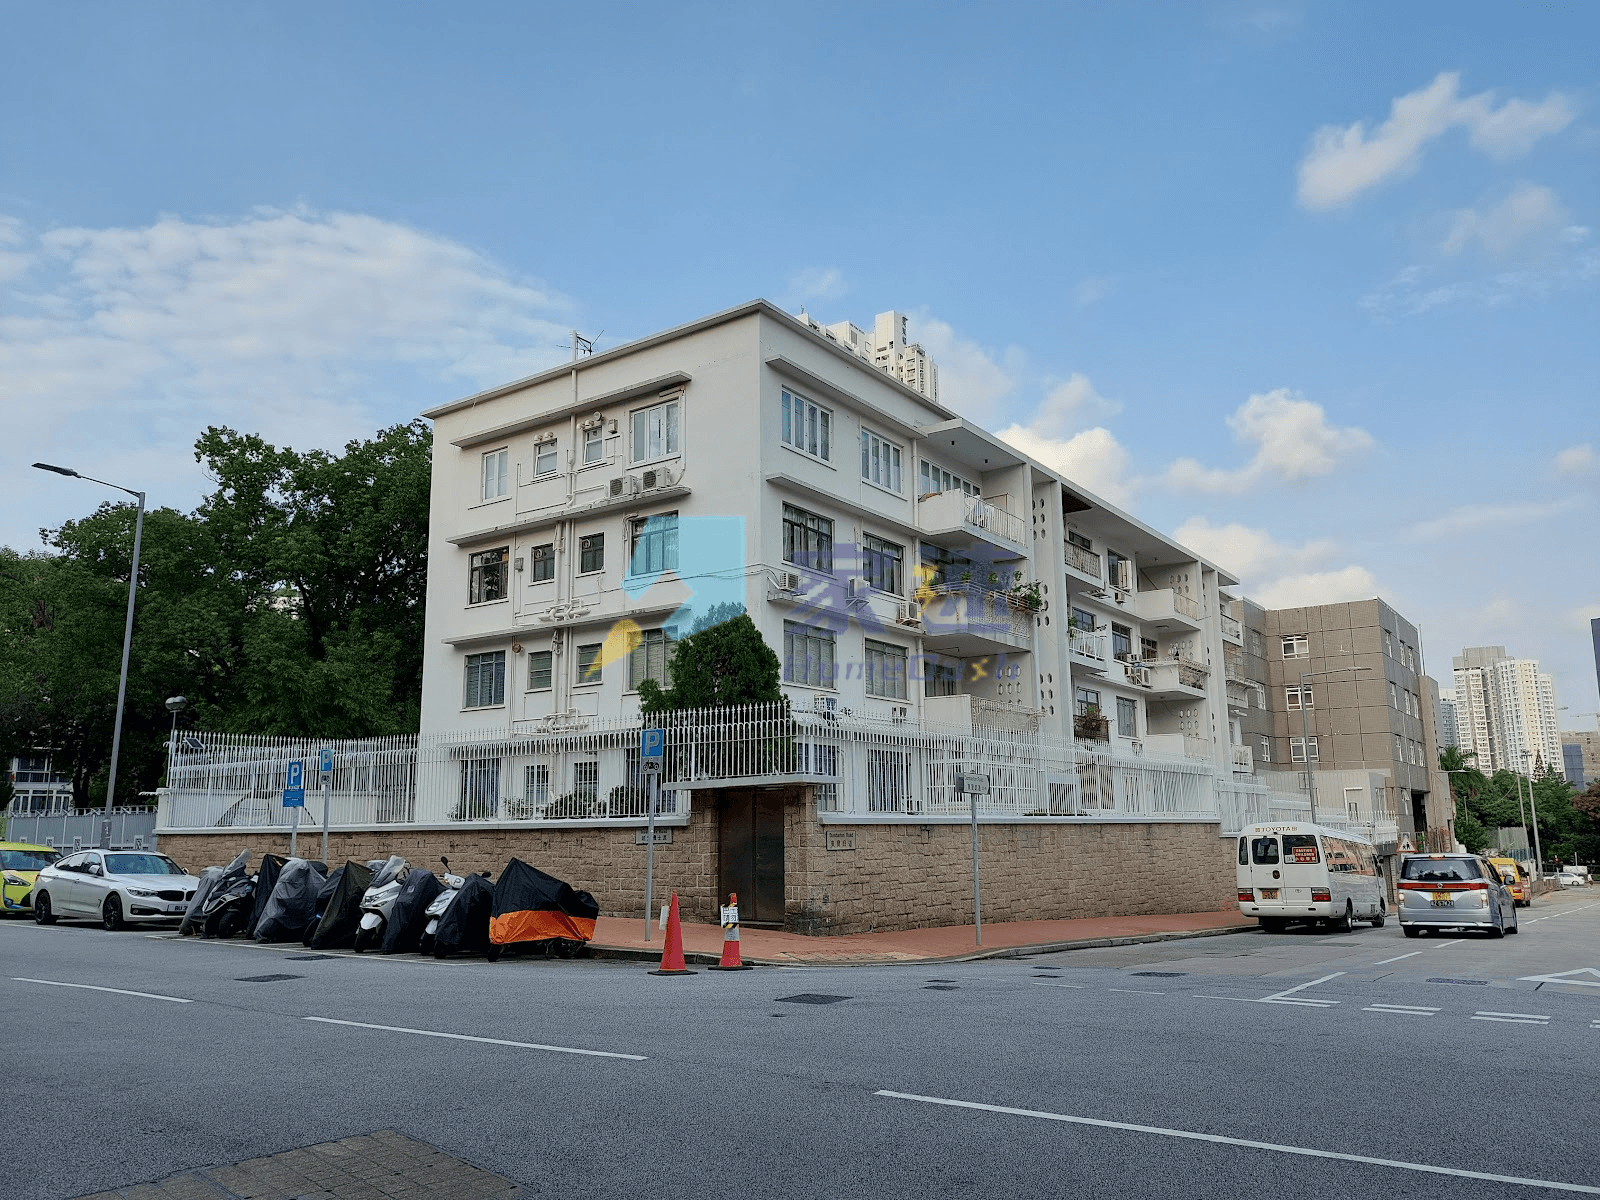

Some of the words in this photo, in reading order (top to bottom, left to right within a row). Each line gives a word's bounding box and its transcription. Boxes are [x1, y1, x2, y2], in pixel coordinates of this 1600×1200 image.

[645, 731, 660, 756] P
[322, 751, 333, 771] P
[290, 763, 300, 785] P
